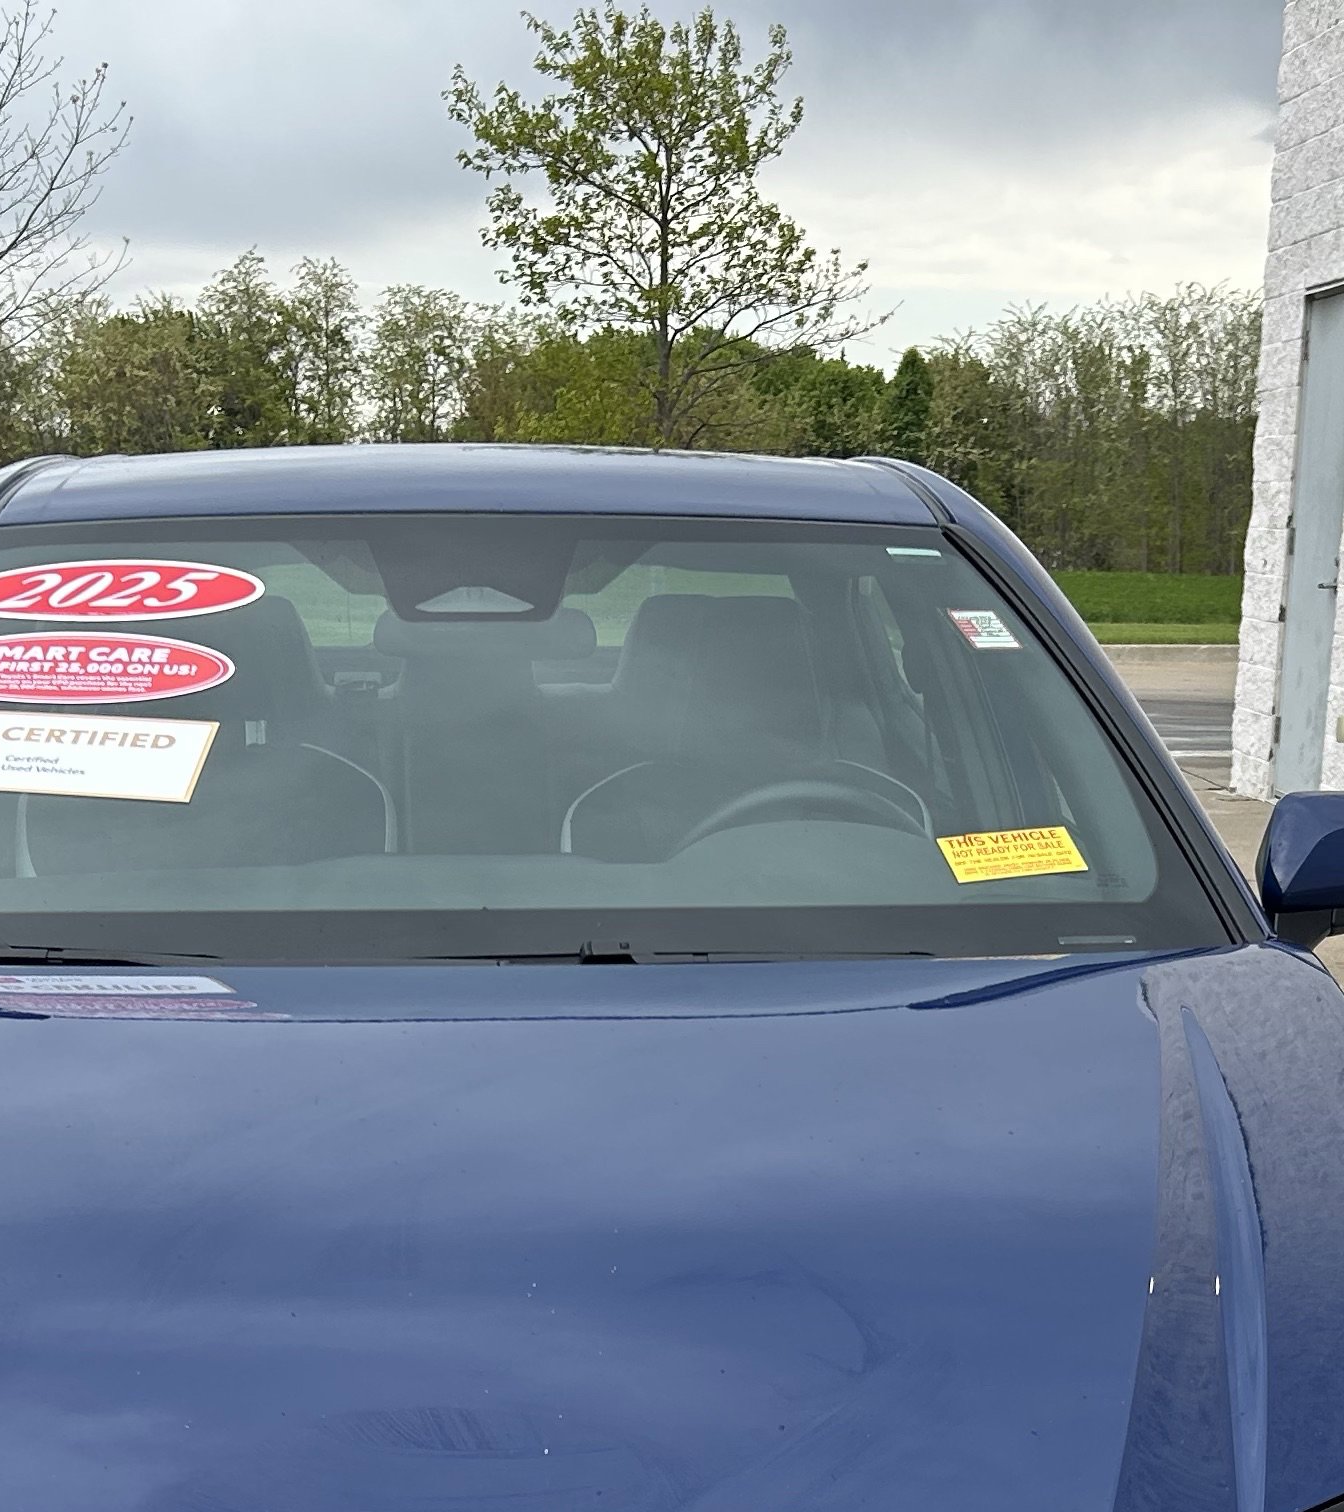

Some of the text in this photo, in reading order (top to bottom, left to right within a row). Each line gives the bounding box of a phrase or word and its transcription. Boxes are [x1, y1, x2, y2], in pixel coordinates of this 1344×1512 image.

[88, 646, 171, 663] CARE
[55, 662, 124, 675] 25,000
[126, 663, 161, 675] ON
[162, 664, 198, 677] US!
[1, 726, 176, 749] CERTIFIED
[945, 829, 1061, 849] THIS VEHICLE
[952, 848, 974, 859] NOT
[976, 844, 1012, 857] READY
[1014, 842, 1036, 854] FOR
[1039, 840, 1065, 851] SALE
